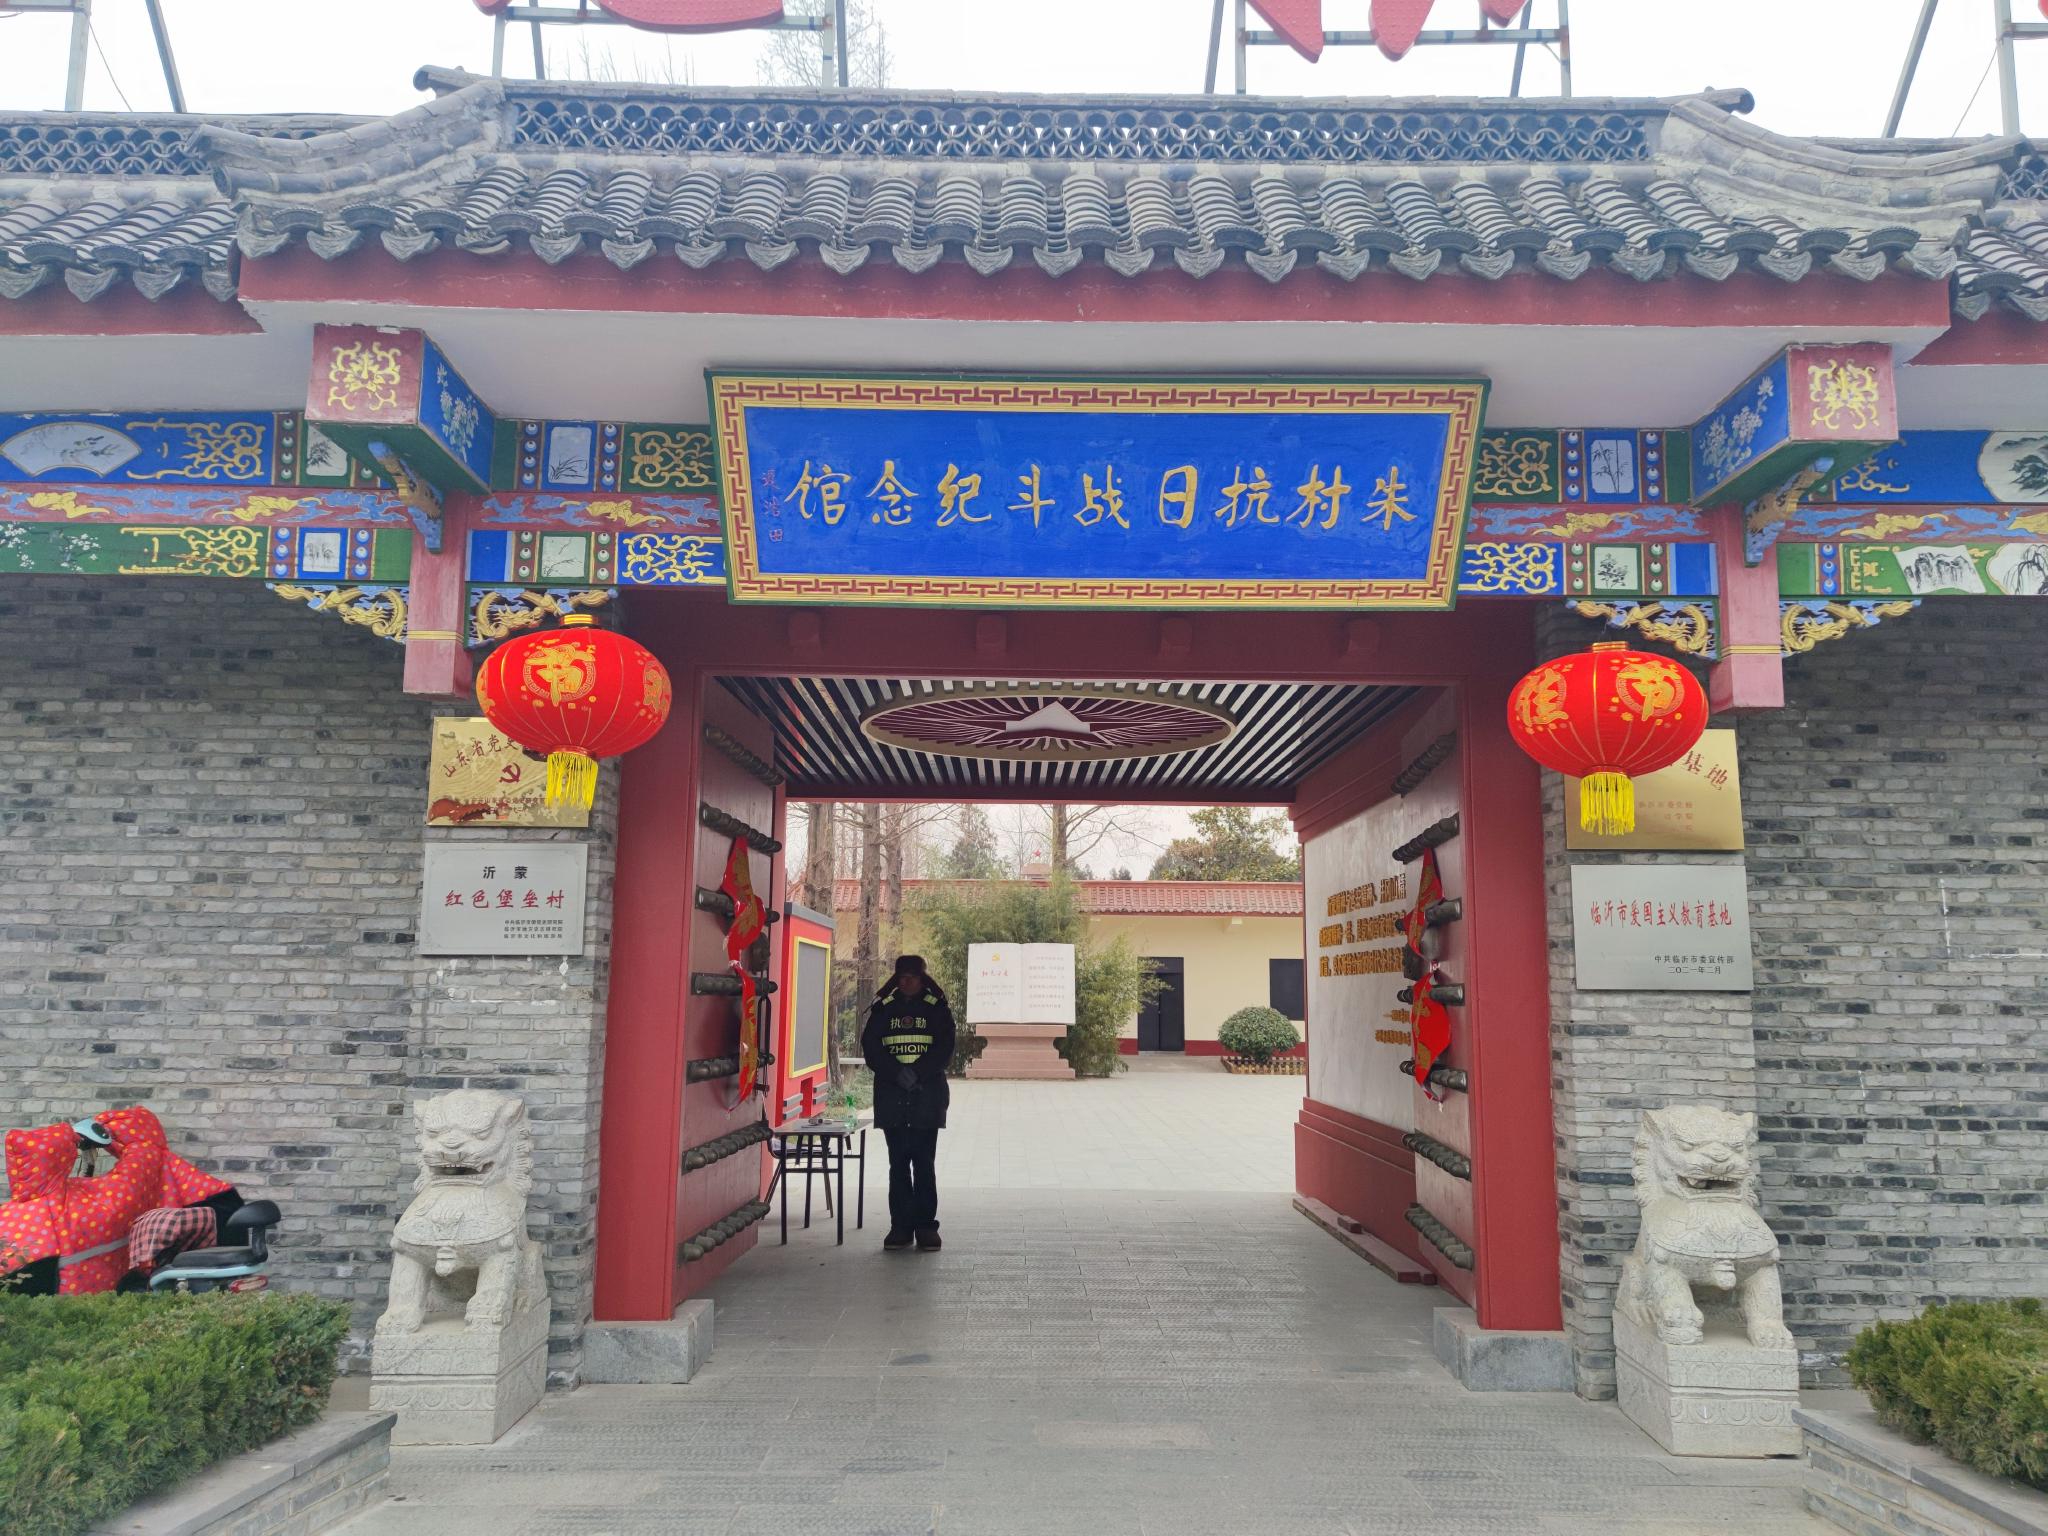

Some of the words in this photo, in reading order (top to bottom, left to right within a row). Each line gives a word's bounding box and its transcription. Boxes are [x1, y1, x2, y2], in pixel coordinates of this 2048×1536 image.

[444, 889, 565, 909] 红色堡垒村
[1590, 899, 1732, 929] 临沂市爱国主义教育基地
[889, 1044, 928, 1054] ZHIQIN
